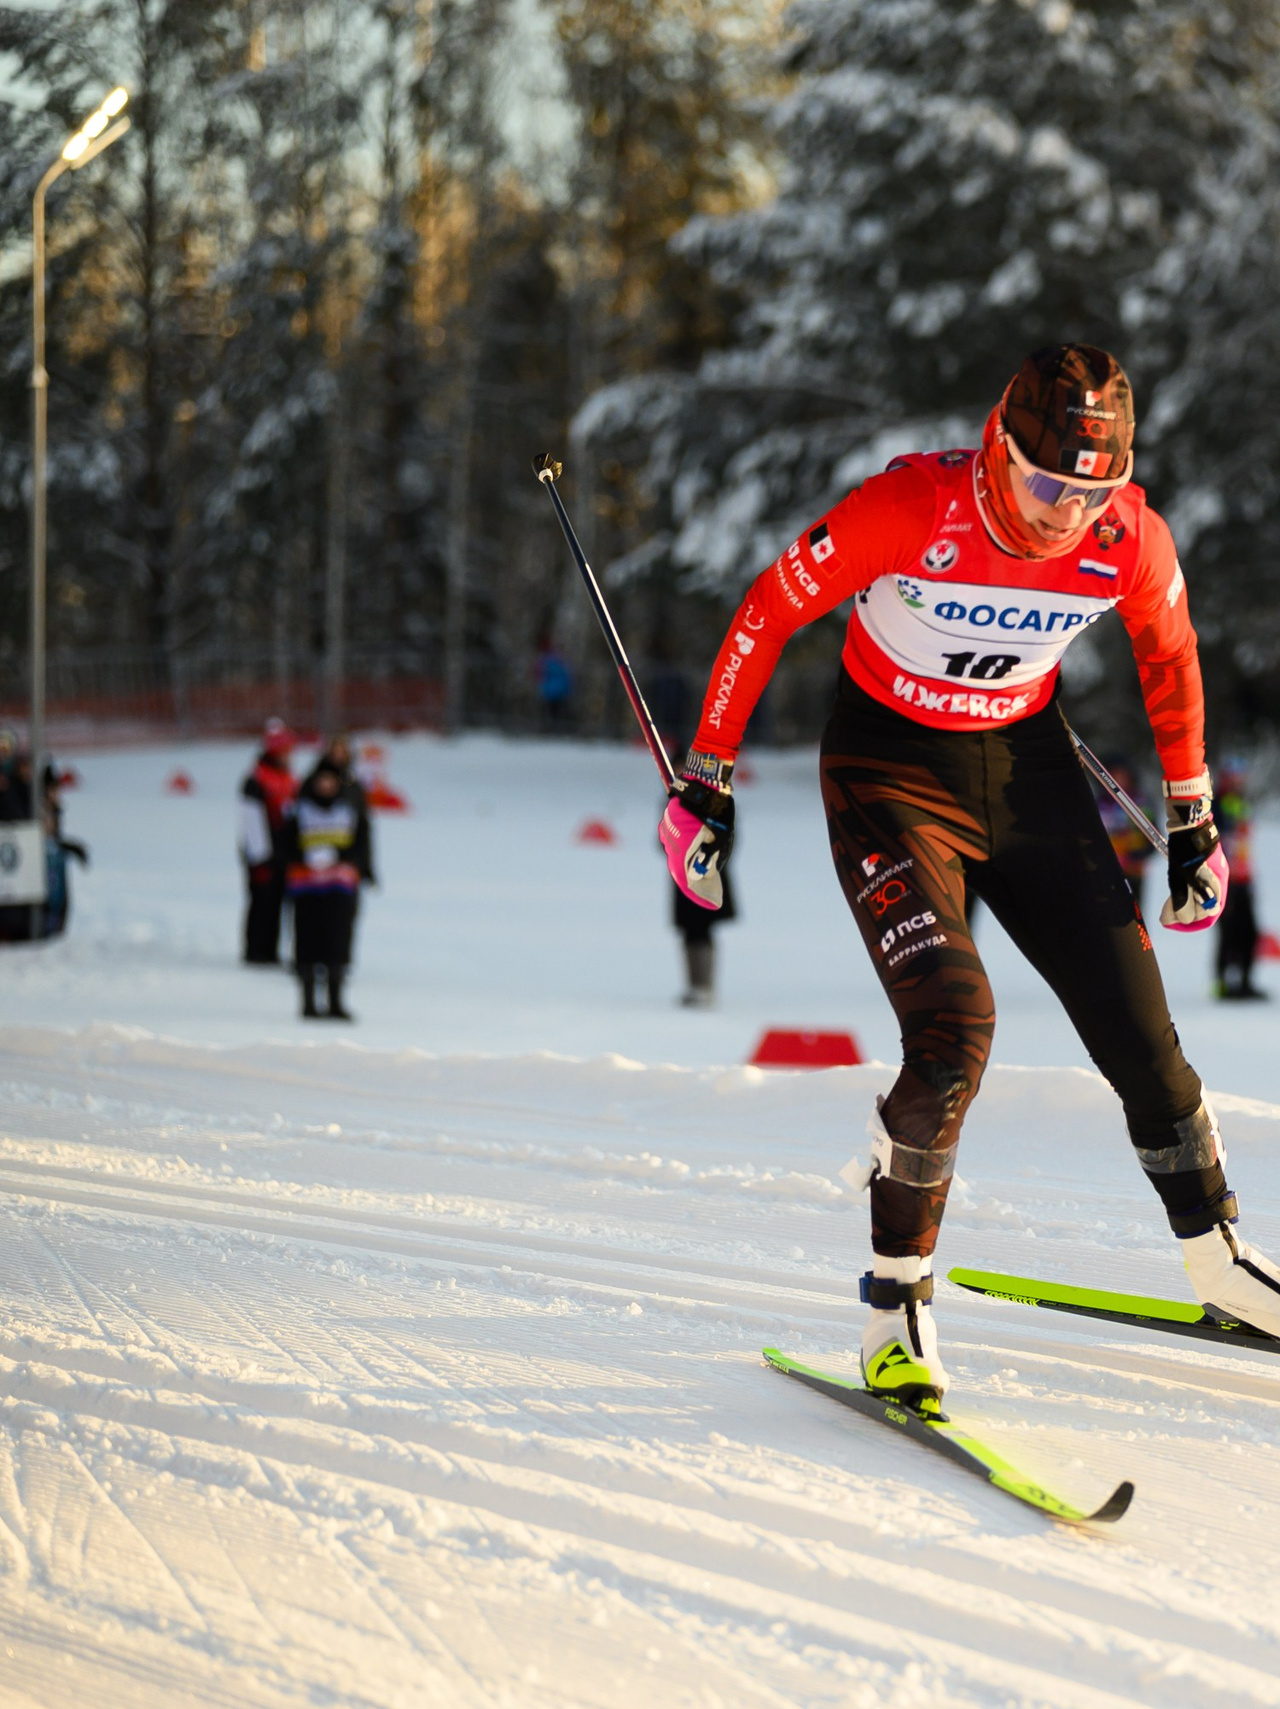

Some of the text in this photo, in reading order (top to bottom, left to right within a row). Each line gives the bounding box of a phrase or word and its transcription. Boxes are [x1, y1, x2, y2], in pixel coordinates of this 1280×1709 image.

[791, 559, 820, 597] ПСБ
[856, 858, 914, 904] РУСКЛИМАТ
[870, 880, 906, 915] 30
[897, 910, 937, 937] ПСБ
[888, 933, 948, 967] БАРРАКУДА
[885, 1407, 908, 1427] FISCHER
